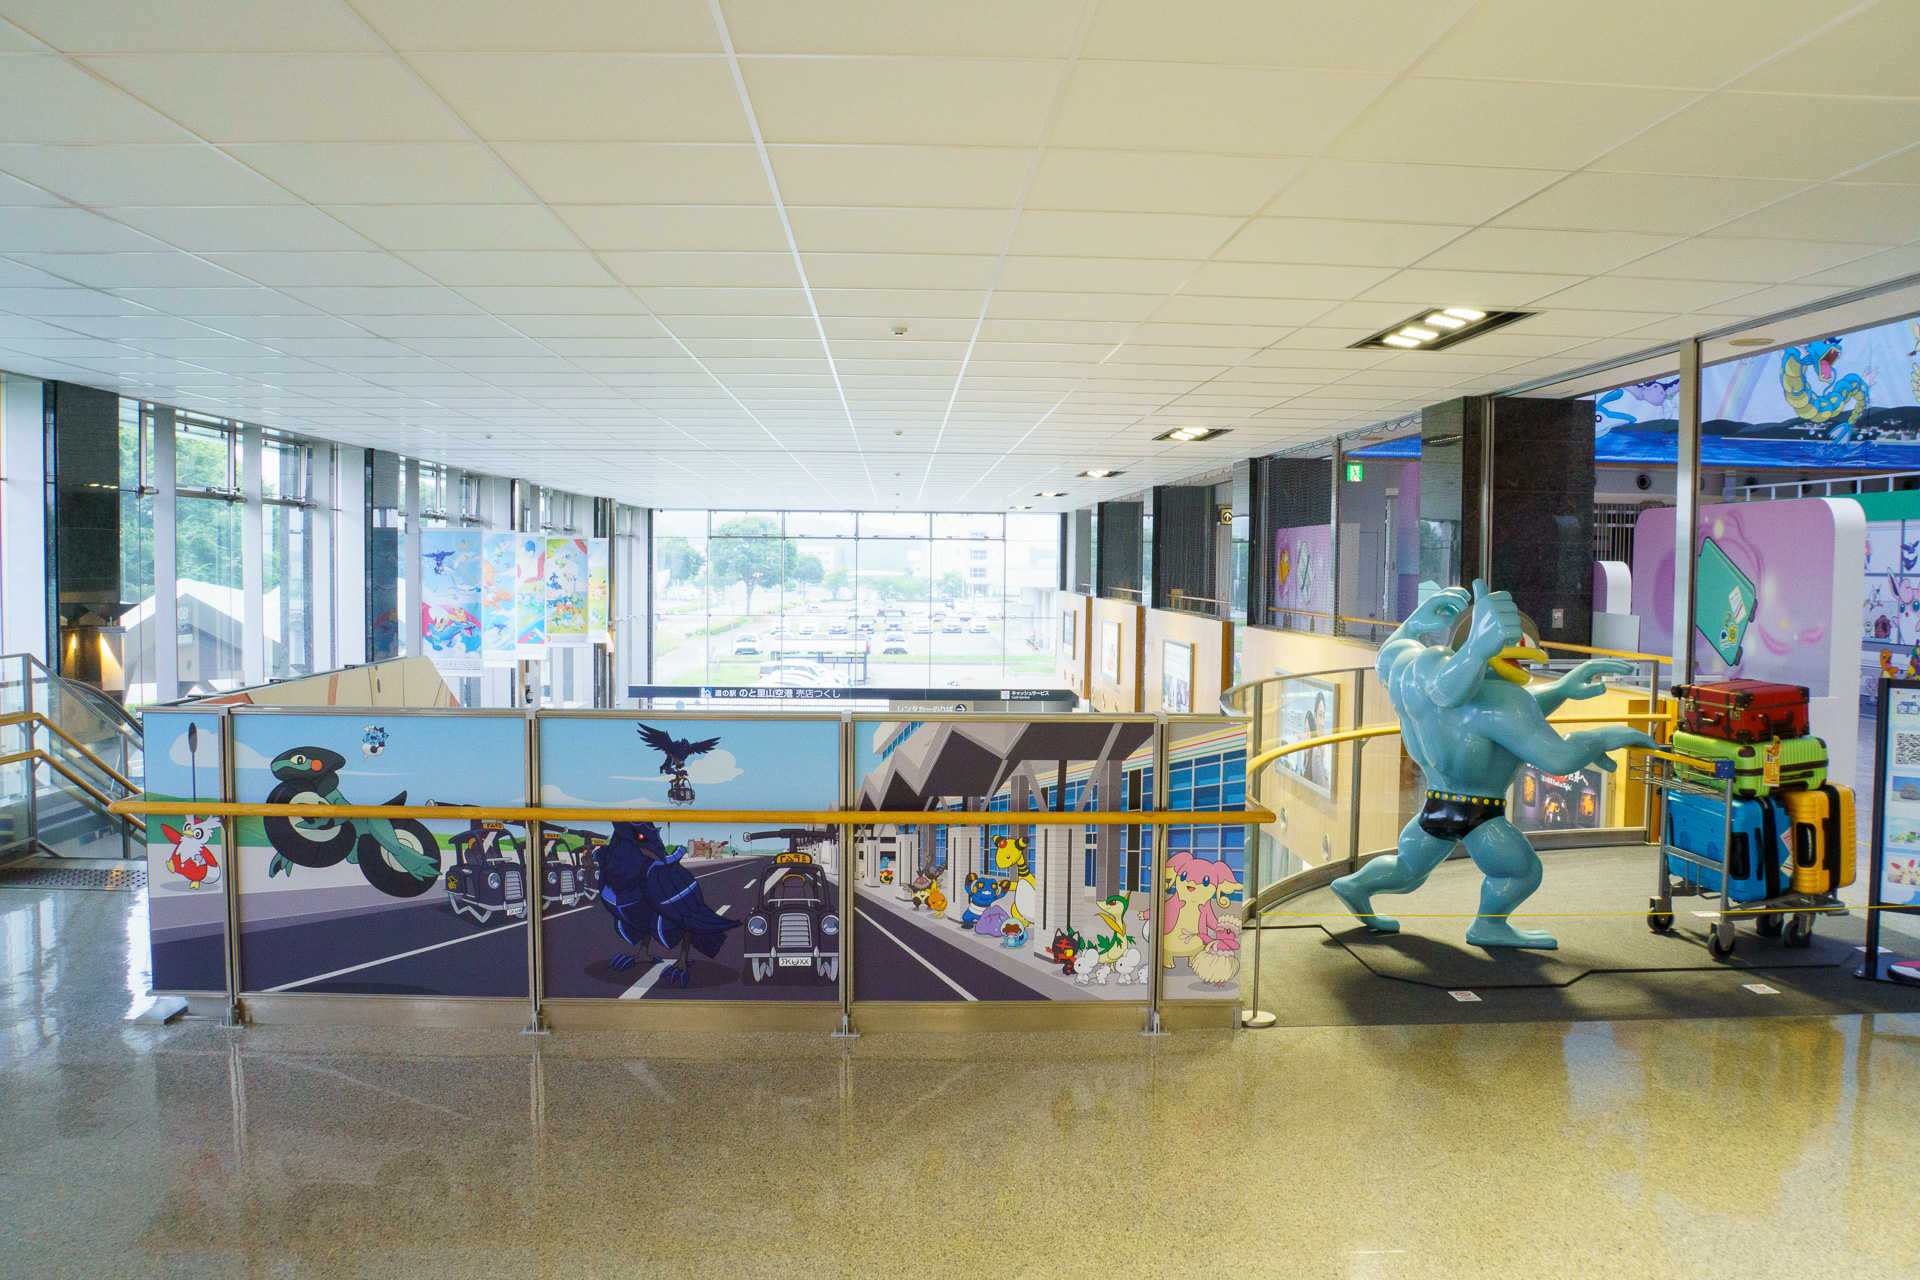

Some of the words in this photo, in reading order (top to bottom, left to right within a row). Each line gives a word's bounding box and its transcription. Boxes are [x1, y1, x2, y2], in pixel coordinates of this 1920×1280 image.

[714, 689, 737, 697] 道の駅
[738, 688, 794, 698] のと里山空港
[795, 689, 841, 698] 売店つくし
